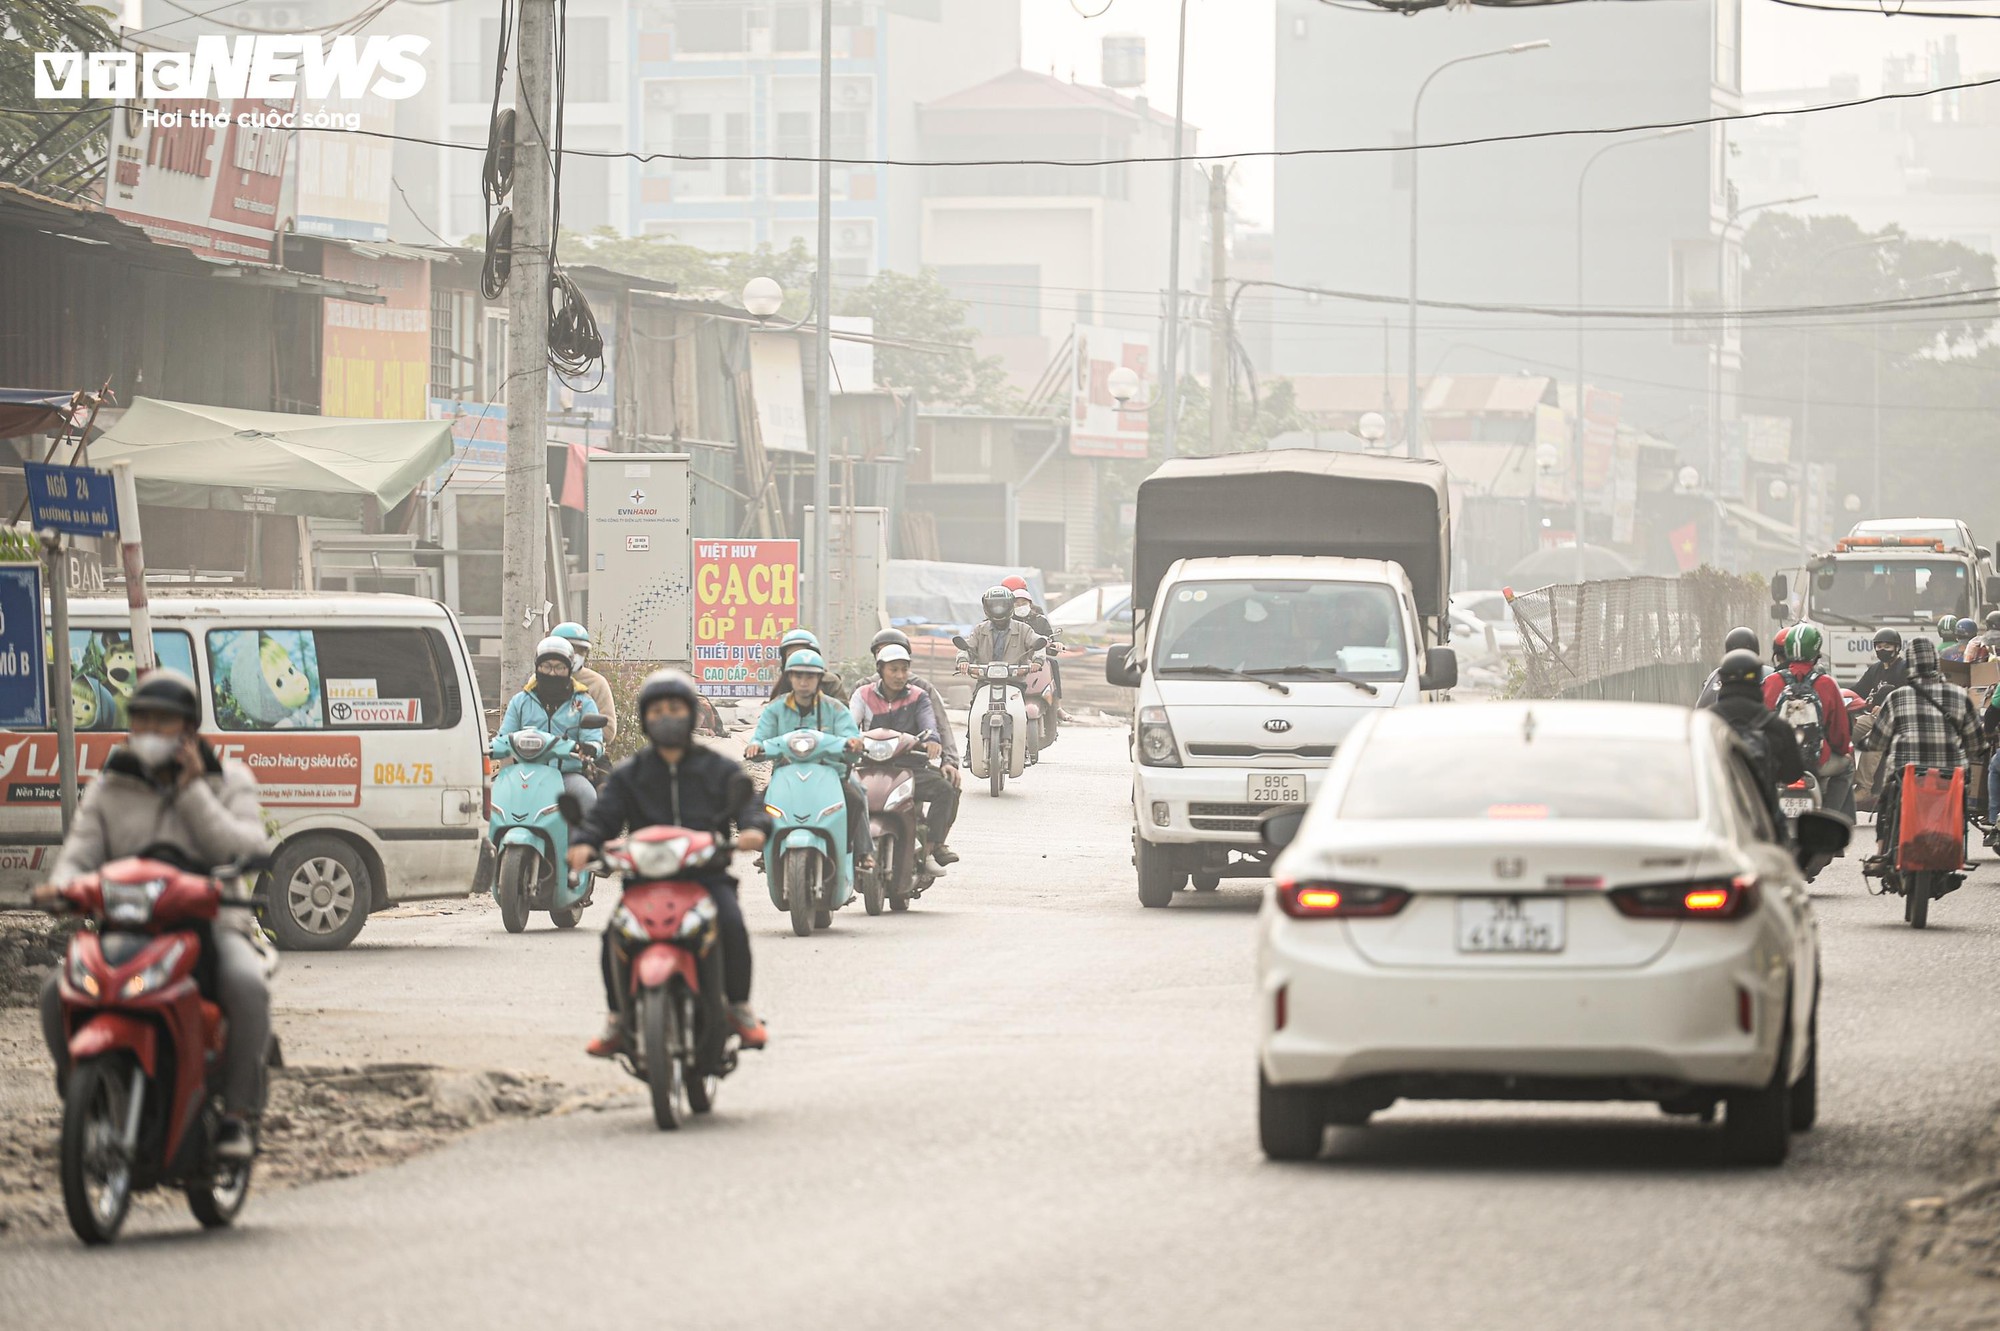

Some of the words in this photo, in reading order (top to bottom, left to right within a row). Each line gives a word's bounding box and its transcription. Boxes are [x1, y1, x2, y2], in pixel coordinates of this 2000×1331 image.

[76, 476, 89, 499] 24
[699, 543, 728, 560] VIỆT
[731, 545, 757, 558] HUY
[70, 552, 105, 591] BÁN
[697, 563, 795, 617] GẠCH
[698, 609, 735, 640] ỐP
[745, 613, 794, 640] LÁT
[696, 642, 728, 659] THIẾT
[732, 645, 744, 662] BỊ
[748, 643, 762, 662] VỆ
[765, 645, 782, 660] SI
[20, 652, 30, 676] B
[704, 668, 724, 681] CAO
[727, 663, 747, 681] CẤP
[329, 688, 375, 697] HIACE
[353, 709, 405, 721] TOYOTA
[1267, 720, 1288, 730] KIA
[248, 753, 277, 768] Giao
[278, 752, 310, 771] hàng
[337, 752, 358, 768] tốc
[1264, 776, 1289, 788] 89C
[1254, 789, 1299, 801] 230.88
[0, 856, 28, 869] OTA
